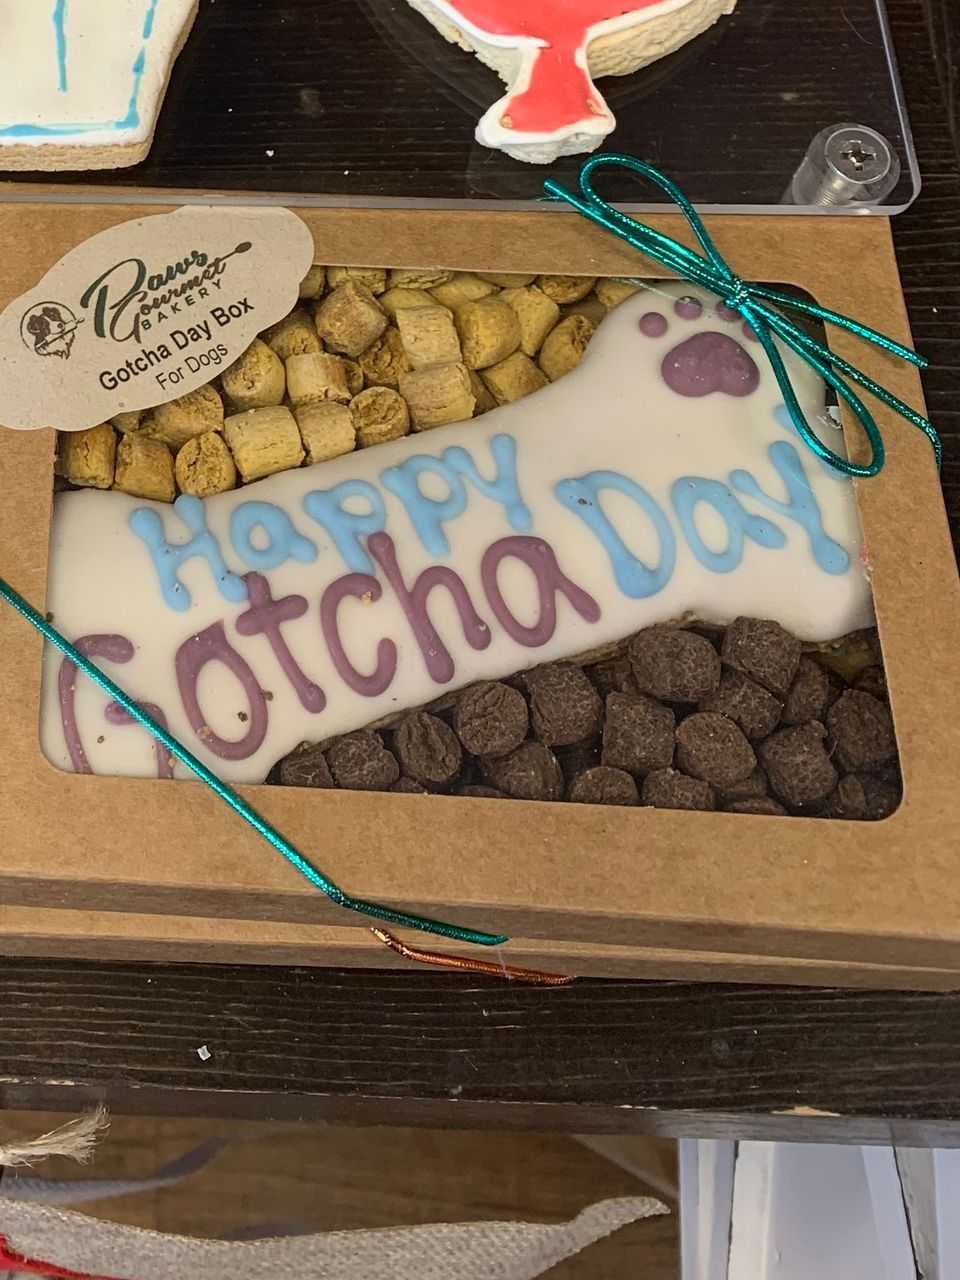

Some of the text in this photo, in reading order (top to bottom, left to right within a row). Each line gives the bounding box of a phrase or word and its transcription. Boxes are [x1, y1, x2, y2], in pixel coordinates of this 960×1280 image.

[80, 250, 209, 338] Paws
[109, 257, 227, 344] Gourmet
[141, 278, 224, 332] BAKERY
[98, 296, 256, 392] Gotcha Day Box
[154, 342, 229, 391] For Dogs
